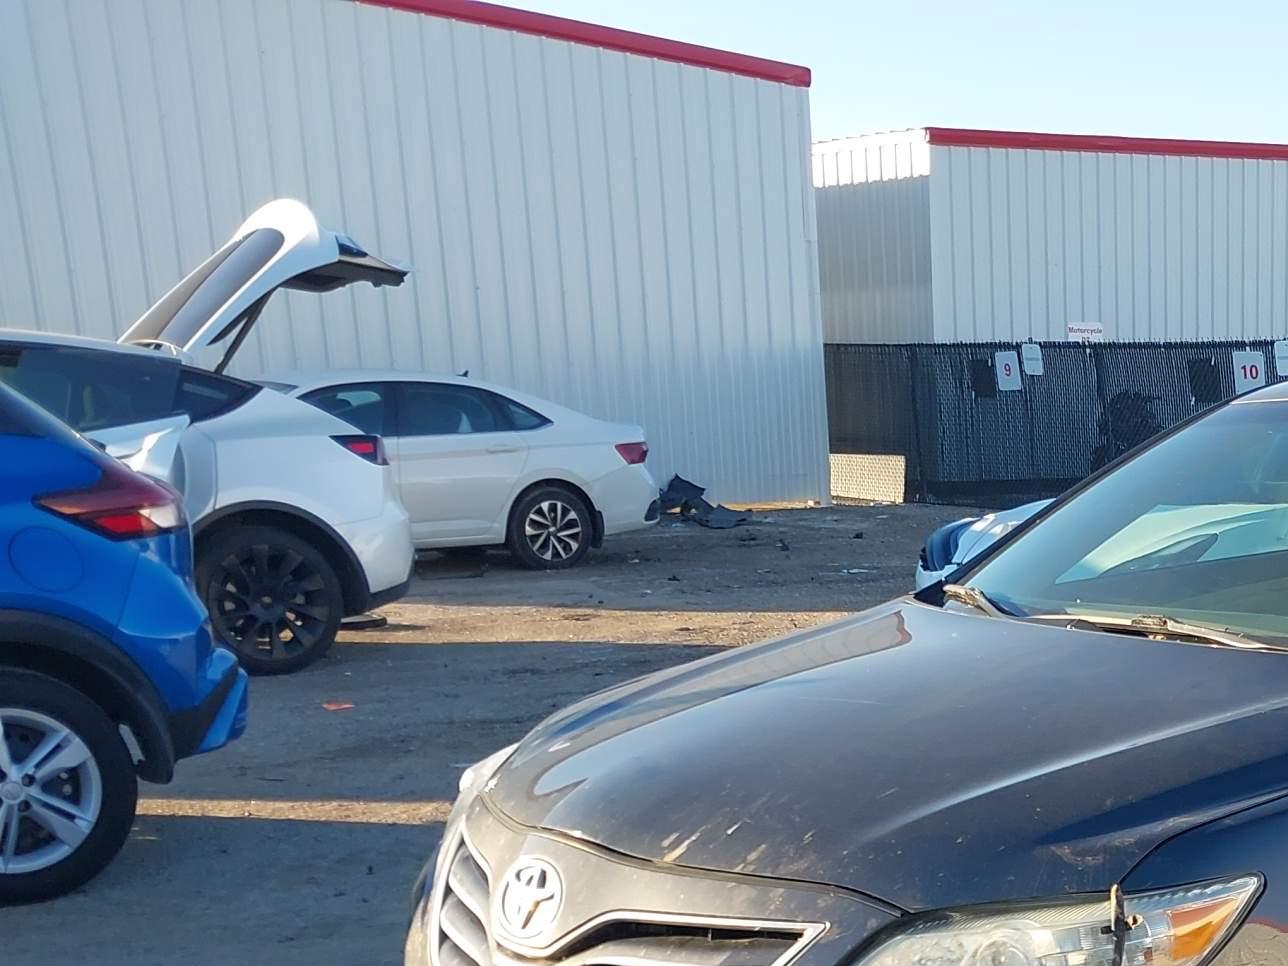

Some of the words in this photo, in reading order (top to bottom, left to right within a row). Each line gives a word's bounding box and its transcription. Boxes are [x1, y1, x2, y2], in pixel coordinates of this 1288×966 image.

[1068, 327, 1103, 335] Motorcycle
[1004, 363, 1011, 377] 9
[1240, 364, 1259, 380] 10
